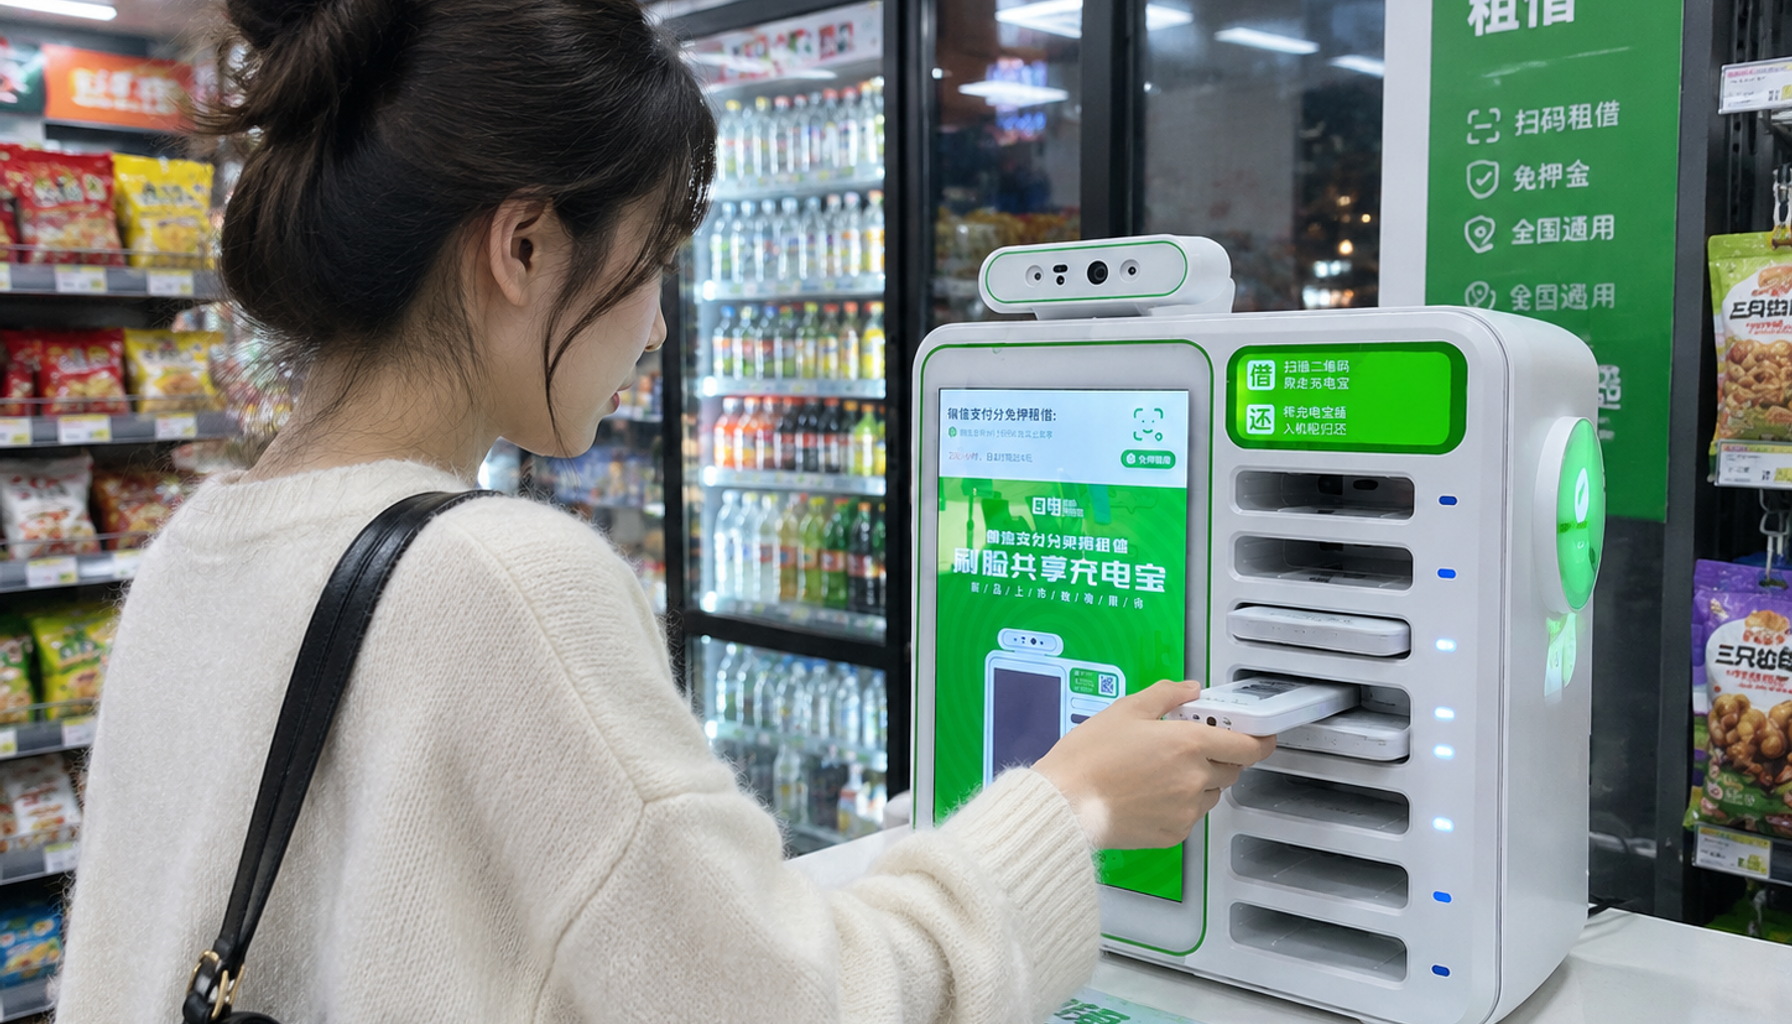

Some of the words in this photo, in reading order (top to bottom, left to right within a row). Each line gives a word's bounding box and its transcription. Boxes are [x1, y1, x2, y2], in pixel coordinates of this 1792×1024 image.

[1515, 100, 1620, 137] 扫码租借
[1513, 159, 1590, 192] 免押金
[1511, 214, 1615, 245] 全国通用
[1250, 364, 1272, 387] 借
[1249, 408, 1271, 430] 还
